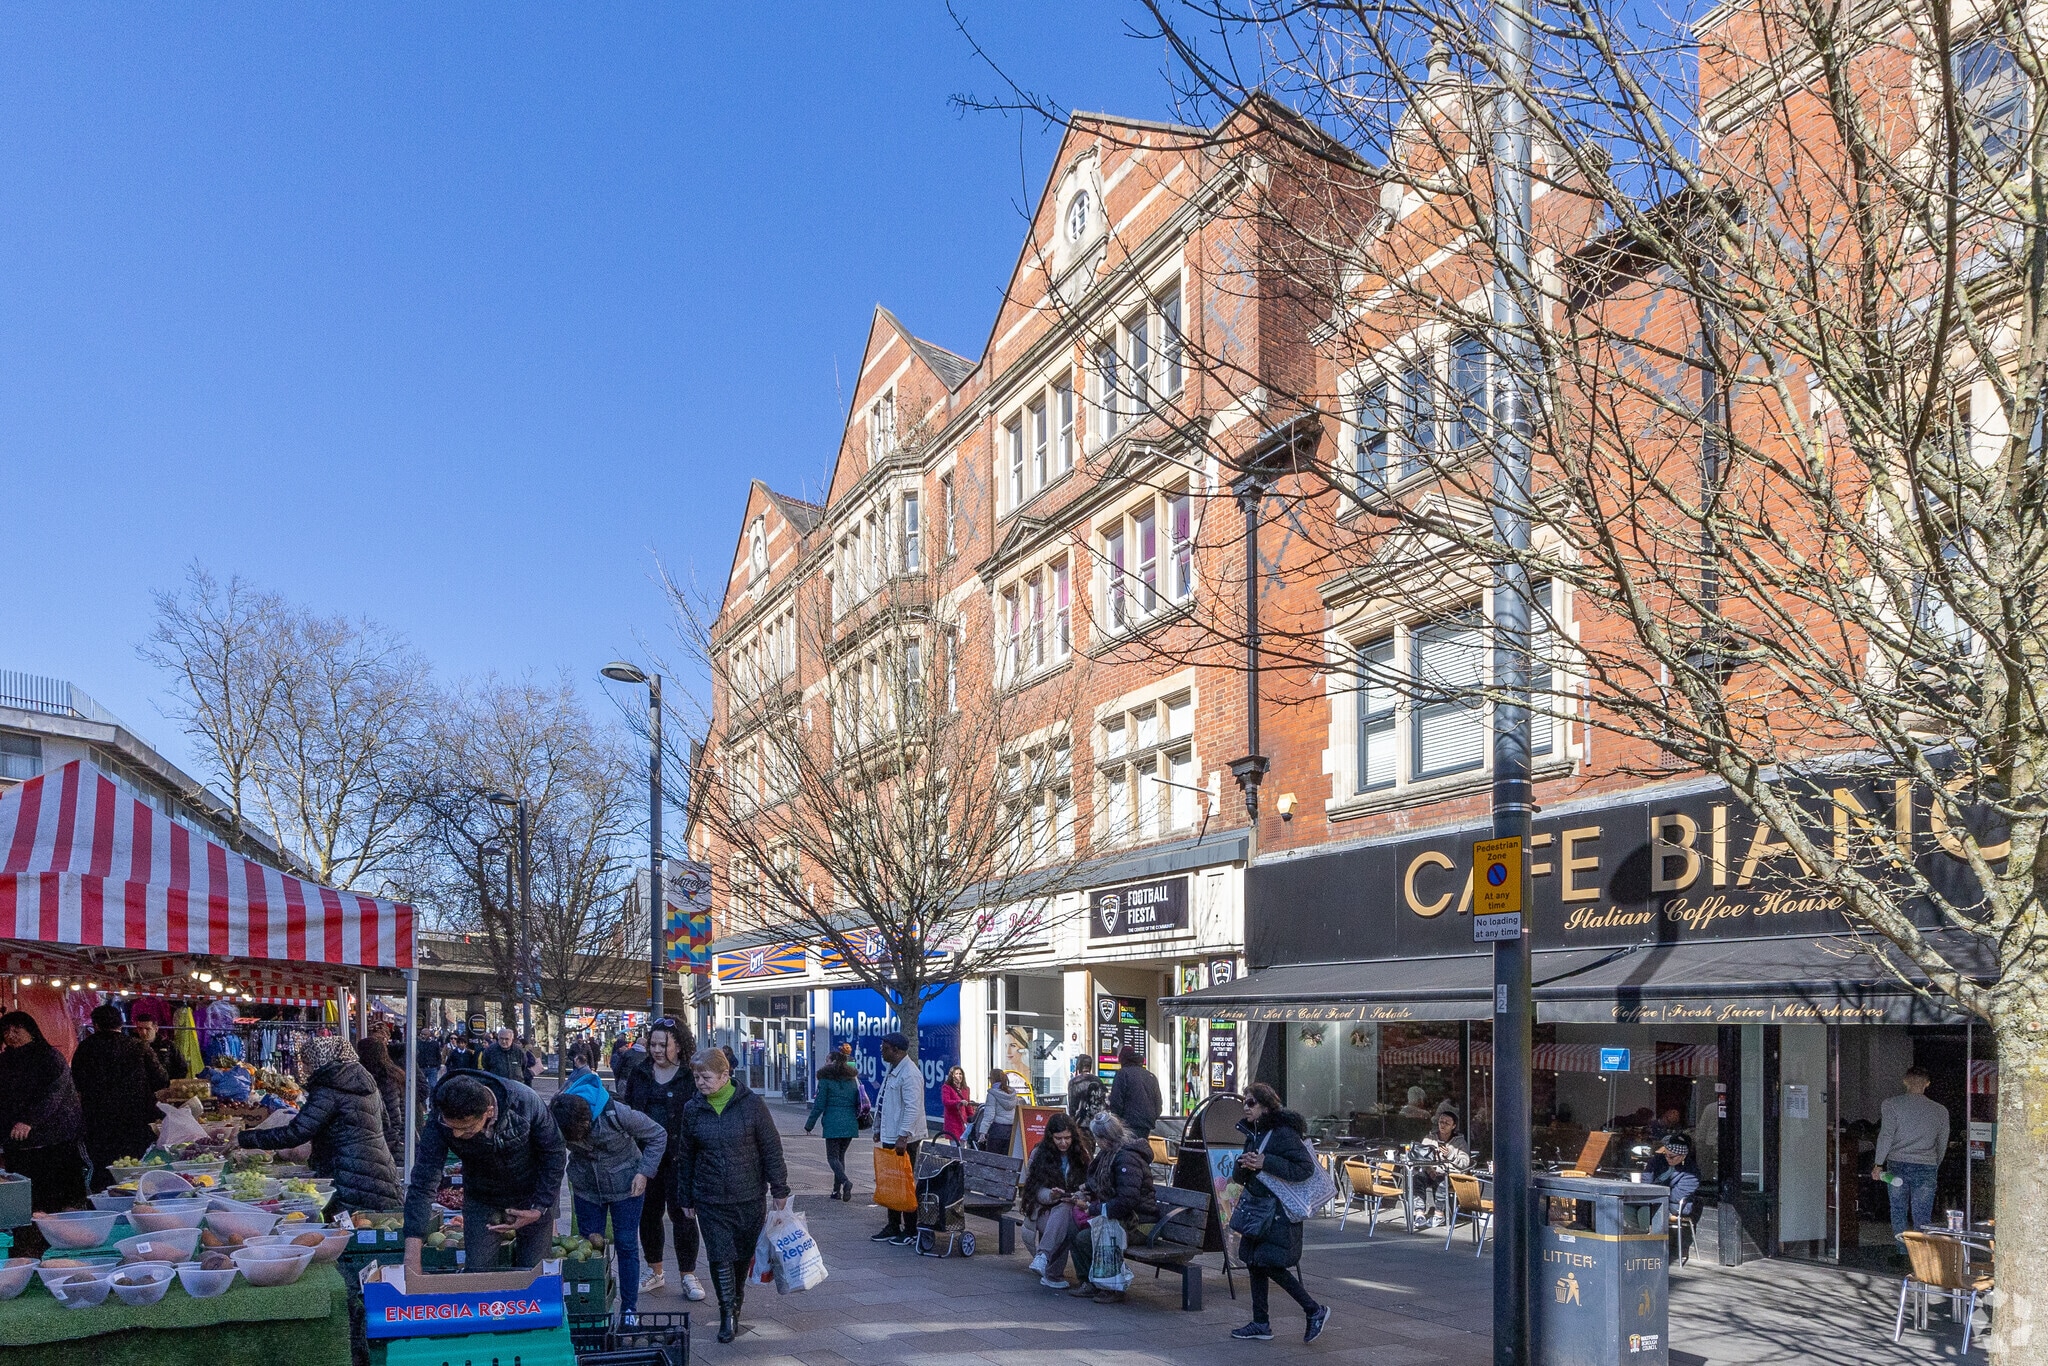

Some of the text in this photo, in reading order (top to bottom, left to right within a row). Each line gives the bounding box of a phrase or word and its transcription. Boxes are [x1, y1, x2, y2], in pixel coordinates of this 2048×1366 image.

[1476, 841, 1519, 853] Pedestrian
[1487, 852, 1507, 861] Zone
[1127, 885, 1169, 907] FOOTBALL
[1484, 891, 1510, 902] At any
[1488, 901, 1506, 910] time
[1564, 889, 1846, 931] Italian Coffee House
[1127, 905, 1156, 925] FIESTA
[1476, 916, 1518, 927] No loading
[1475, 927, 1519, 938] at any time
[1263, 1008, 1282, 1019] Hot
[1298, 1007, 1323, 1019] Cold
[1325, 1007, 1356, 1019] Food
[1370, 1006, 1412, 1019] Salads
[1498, 999, 1505, 1010] 2
[1611, 1003, 1888, 1022] Coffee Fresh Juice Milkshakes
[833, 1010, 854, 1042] Big
[855, 1048, 876, 1083] Big
[777, 1229, 804, 1250] Reuse
[1543, 1249, 1593, 1269] LITTER
[1626, 1258, 1661, 1271] LITTER
[386, 1299, 541, 1322] ENERGIA ROSSA
